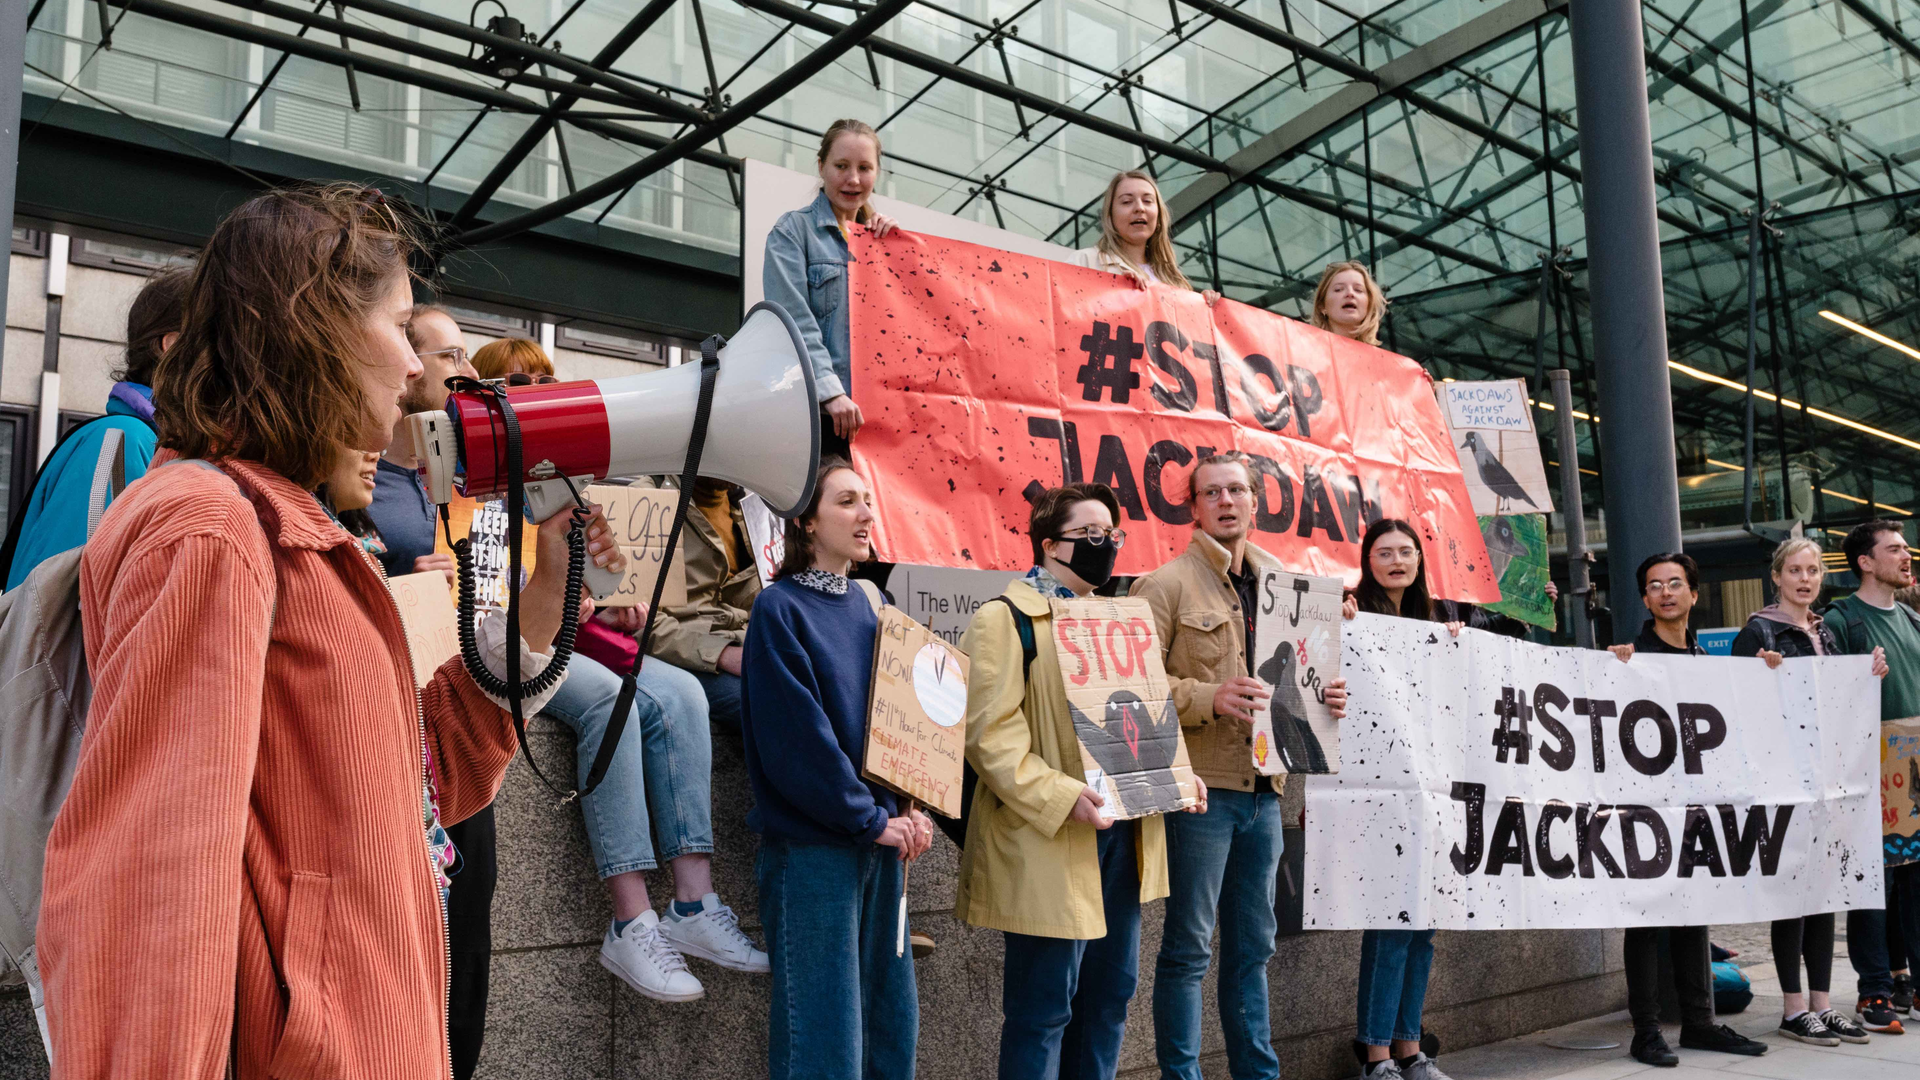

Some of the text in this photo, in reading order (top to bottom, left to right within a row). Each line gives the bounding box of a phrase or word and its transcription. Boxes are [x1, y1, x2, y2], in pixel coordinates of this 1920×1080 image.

[1077, 321, 1323, 437] #STOP
[1450, 388, 1513, 403] JACKDAWS
[1462, 404, 1506, 415] AGAINST
[1466, 415, 1522, 426] JACKDAW
[1022, 416, 1383, 544] JACDAW
[472, 508, 509, 536] KEEP
[471, 542, 508, 568] IT IN
[475, 577, 503, 602] THE
[917, 591, 949, 613] The
[886, 618, 911, 646] ACT
[1708, 640, 1730, 648] EXIT
[1058, 617, 1152, 686] STOP
[881, 650, 913, 687] NOW!
[1492, 683, 1727, 775] #STOP
[872, 727, 928, 768] CLIMATE
[931, 733, 958, 763] Climate
[881, 752, 950, 803] EMERGENCY
[1449, 781, 1795, 879] JACKDAW
